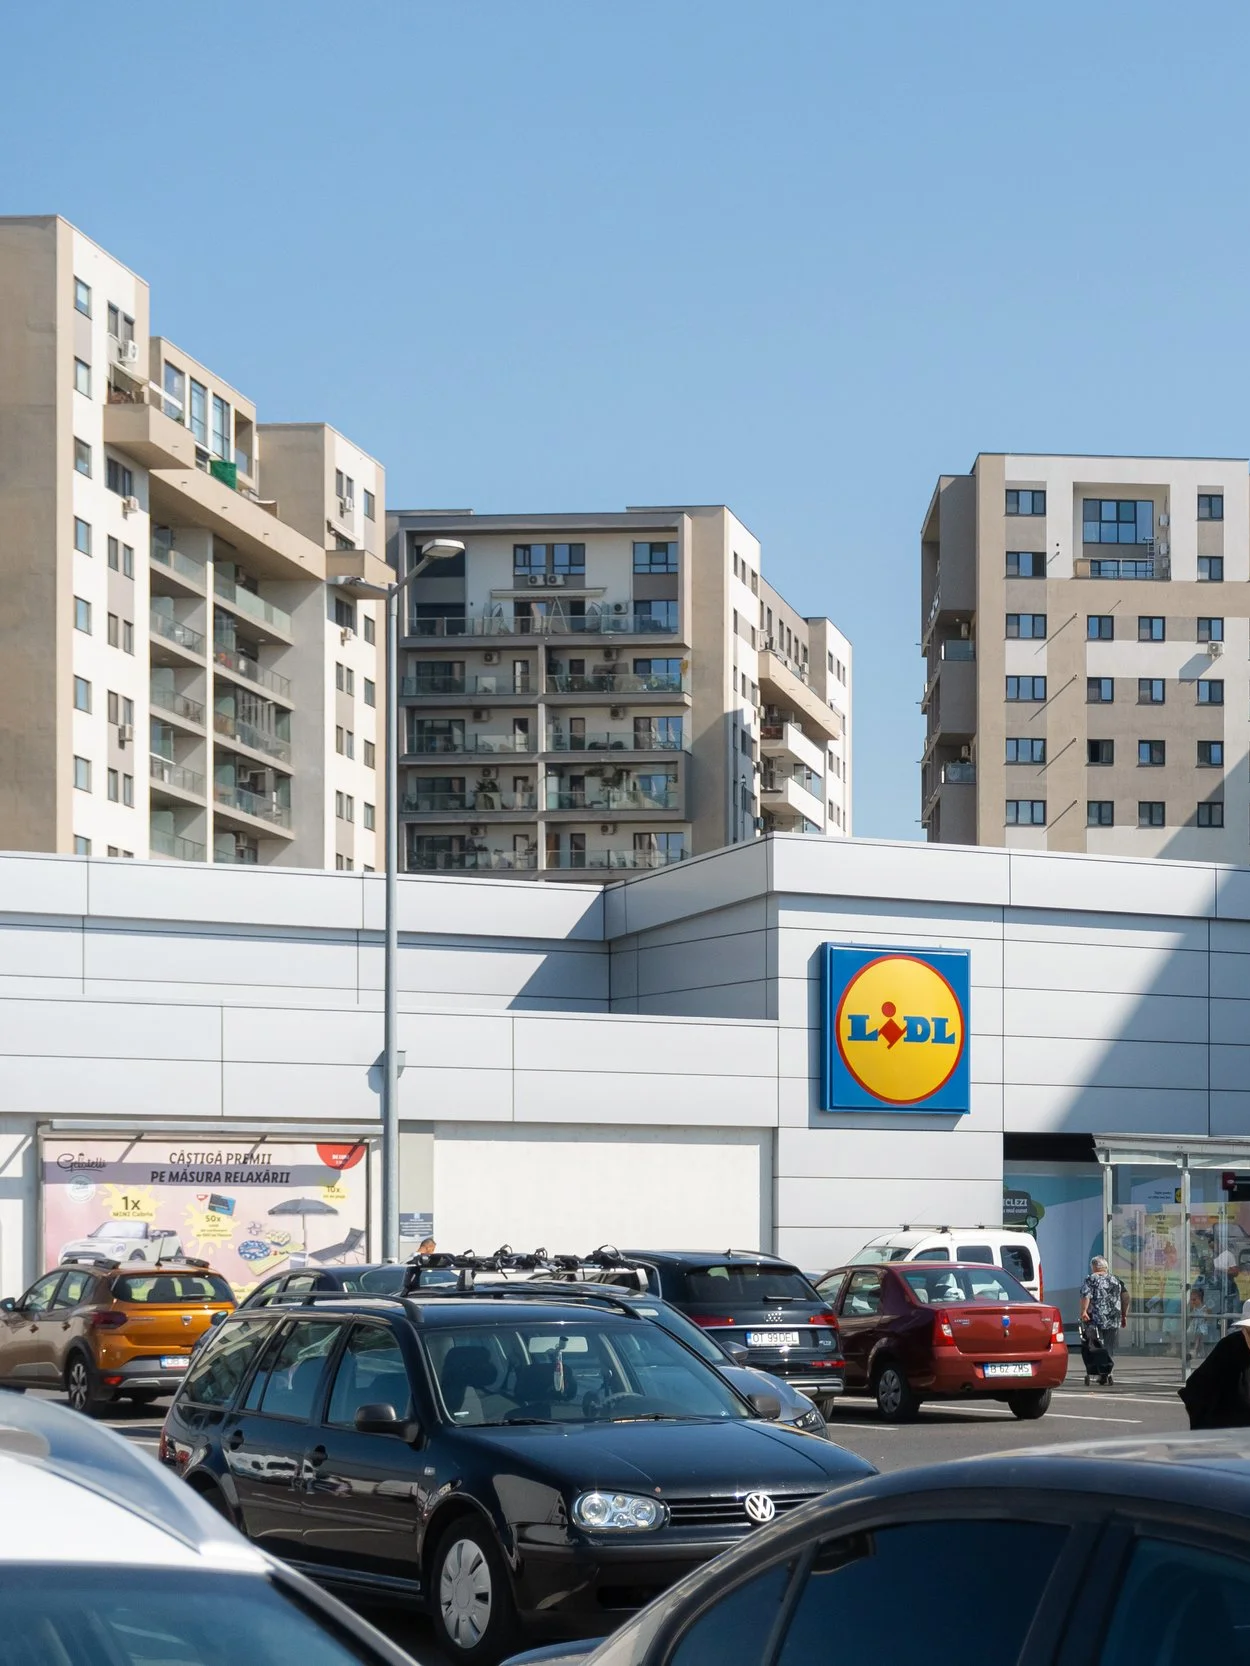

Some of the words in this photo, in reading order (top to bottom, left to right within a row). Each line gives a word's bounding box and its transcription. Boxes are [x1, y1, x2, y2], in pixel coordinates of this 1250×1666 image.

[848, 1001, 955, 1050] LIDL
[226, 1152, 273, 1165] PREMII
[150, 1170, 166, 1183] PE
[168, 1169, 221, 1183] MĂSURA
[224, 1170, 291, 1184] RELAXĂRII
[121, 1195, 141, 1211] 1x
[752, 1333, 764, 1343] OT
[767, 1333, 778, 1343] 99
[779, 1332, 798, 1343] DEL
[990, 1364, 997, 1373] B
[1000, 1364, 1009, 1373] 62
